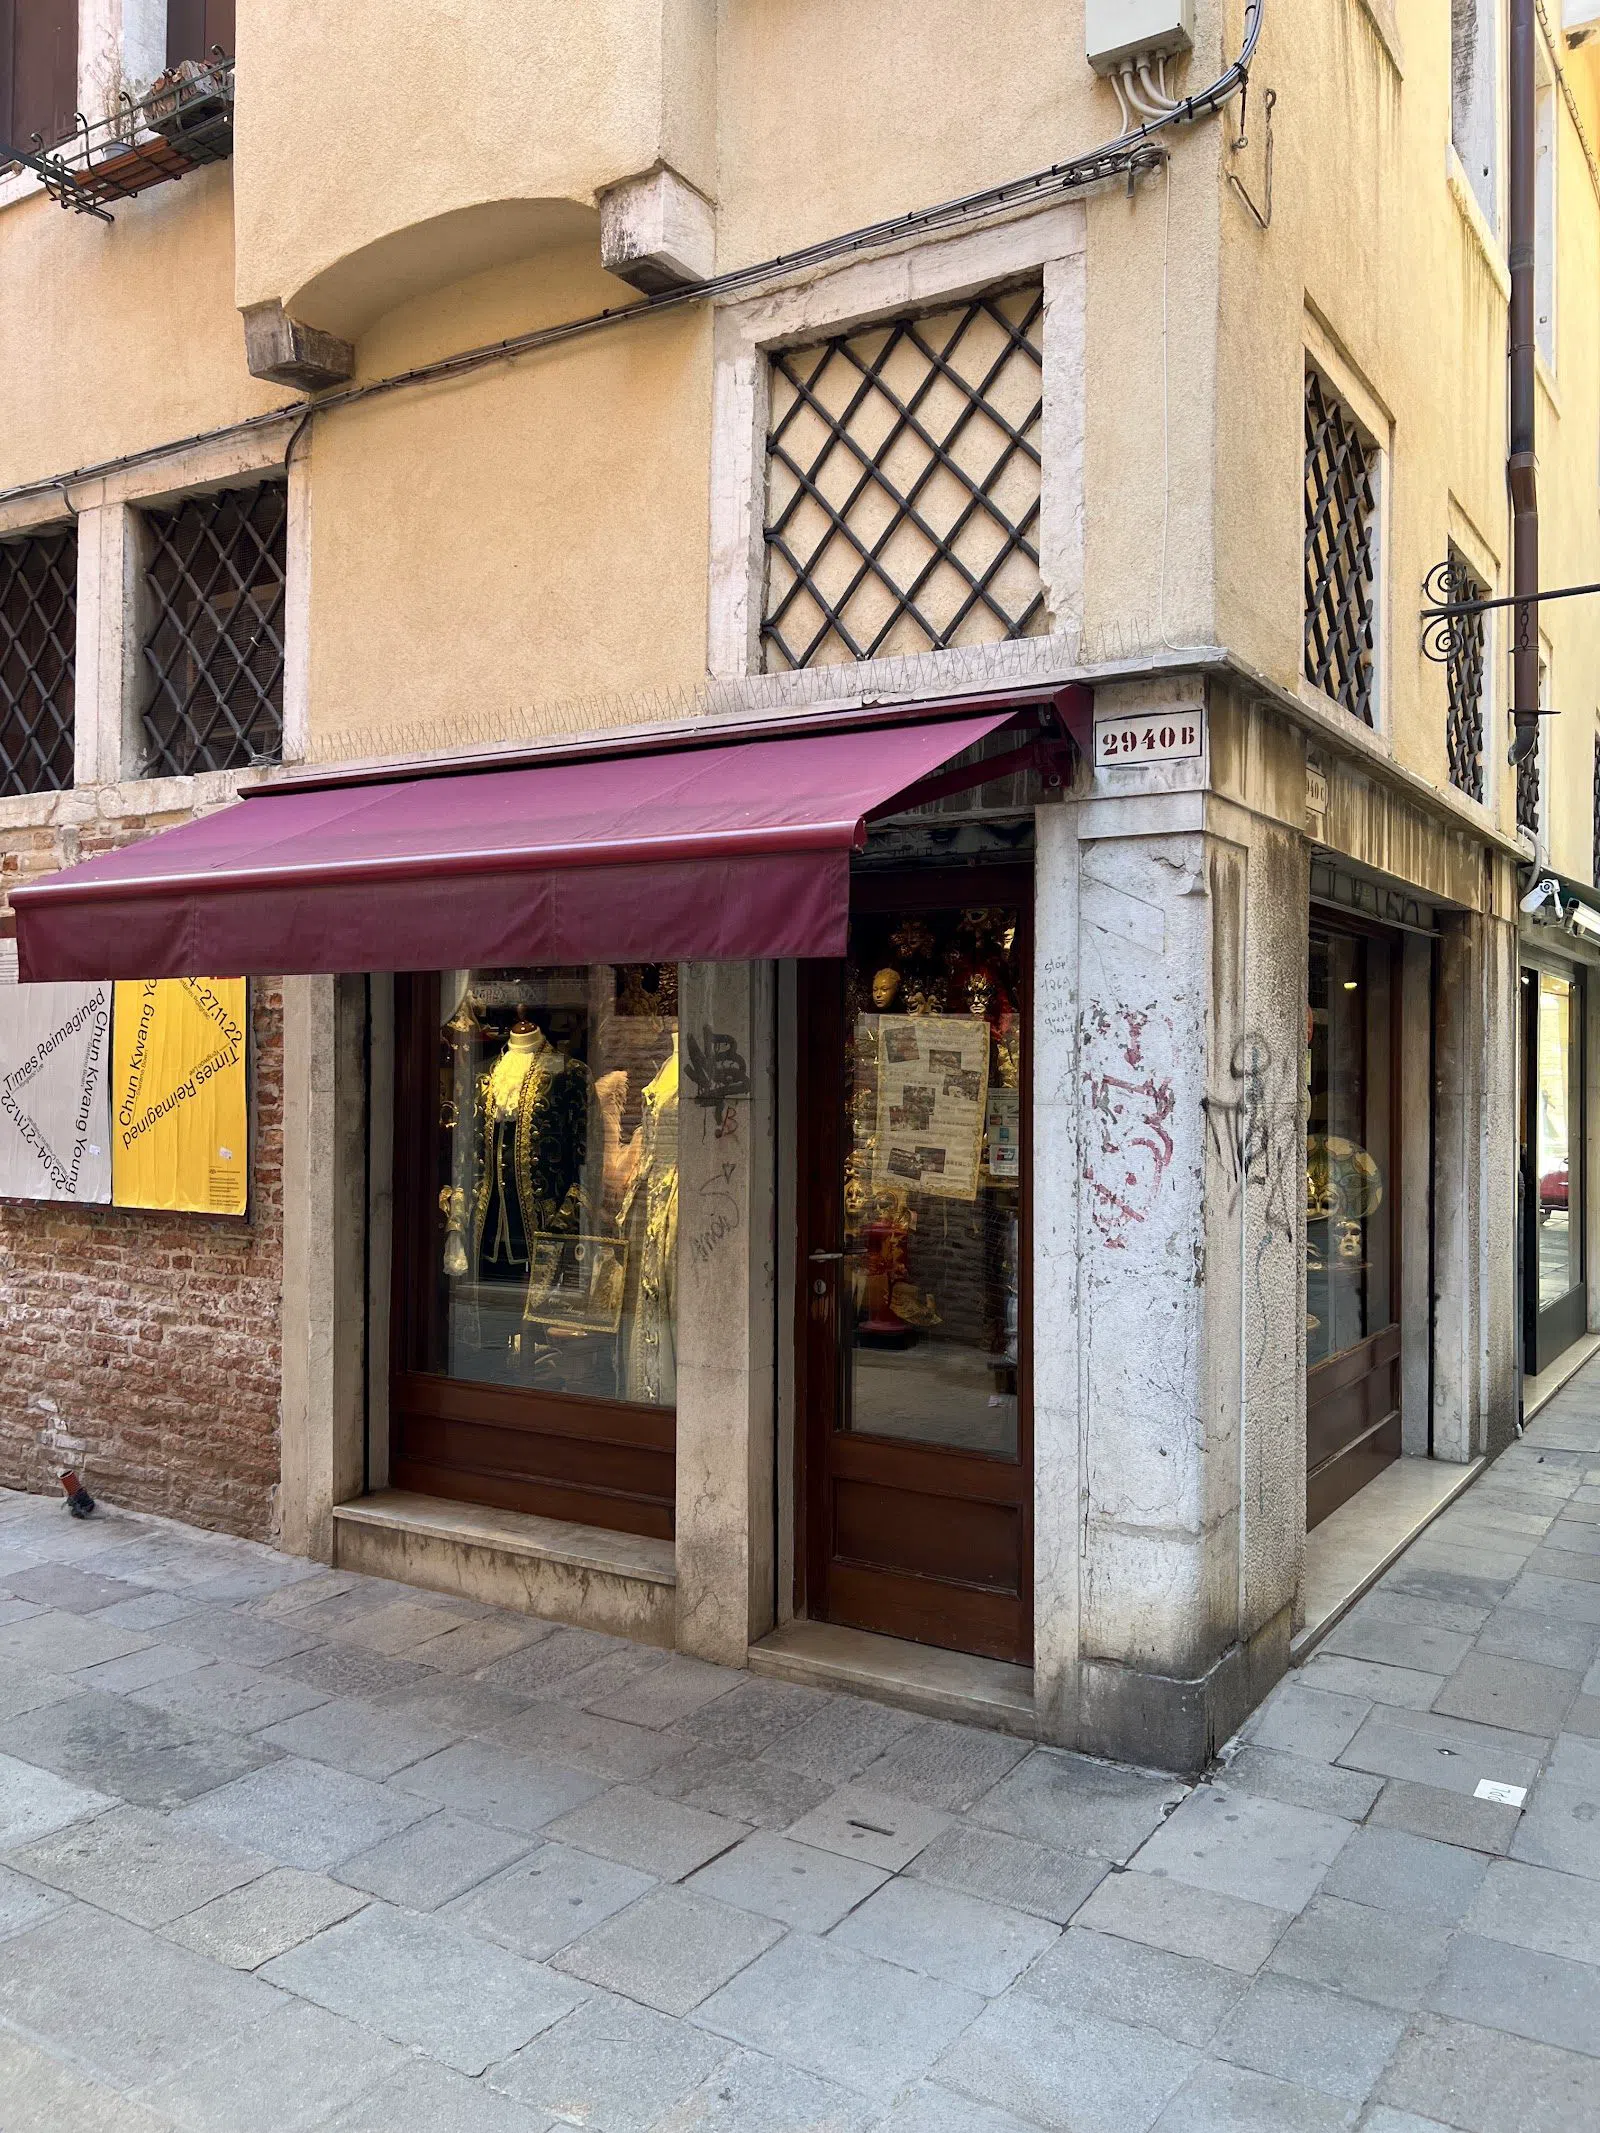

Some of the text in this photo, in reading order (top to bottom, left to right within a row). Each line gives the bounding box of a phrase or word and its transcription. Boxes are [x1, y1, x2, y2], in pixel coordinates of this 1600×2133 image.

[3, 987, 105, 1091] Times Reimagined
[90, 1011, 108, 1061] Chun
[119, 1075, 139, 1126] Chun
[129, 1003, 155, 1071] Kwang
[196, 1047, 239, 1084] Times
[76, 1067, 99, 1131] Kwang
[122, 1079, 197, 1150] Reimagined
[65, 1138, 87, 1194] Young
